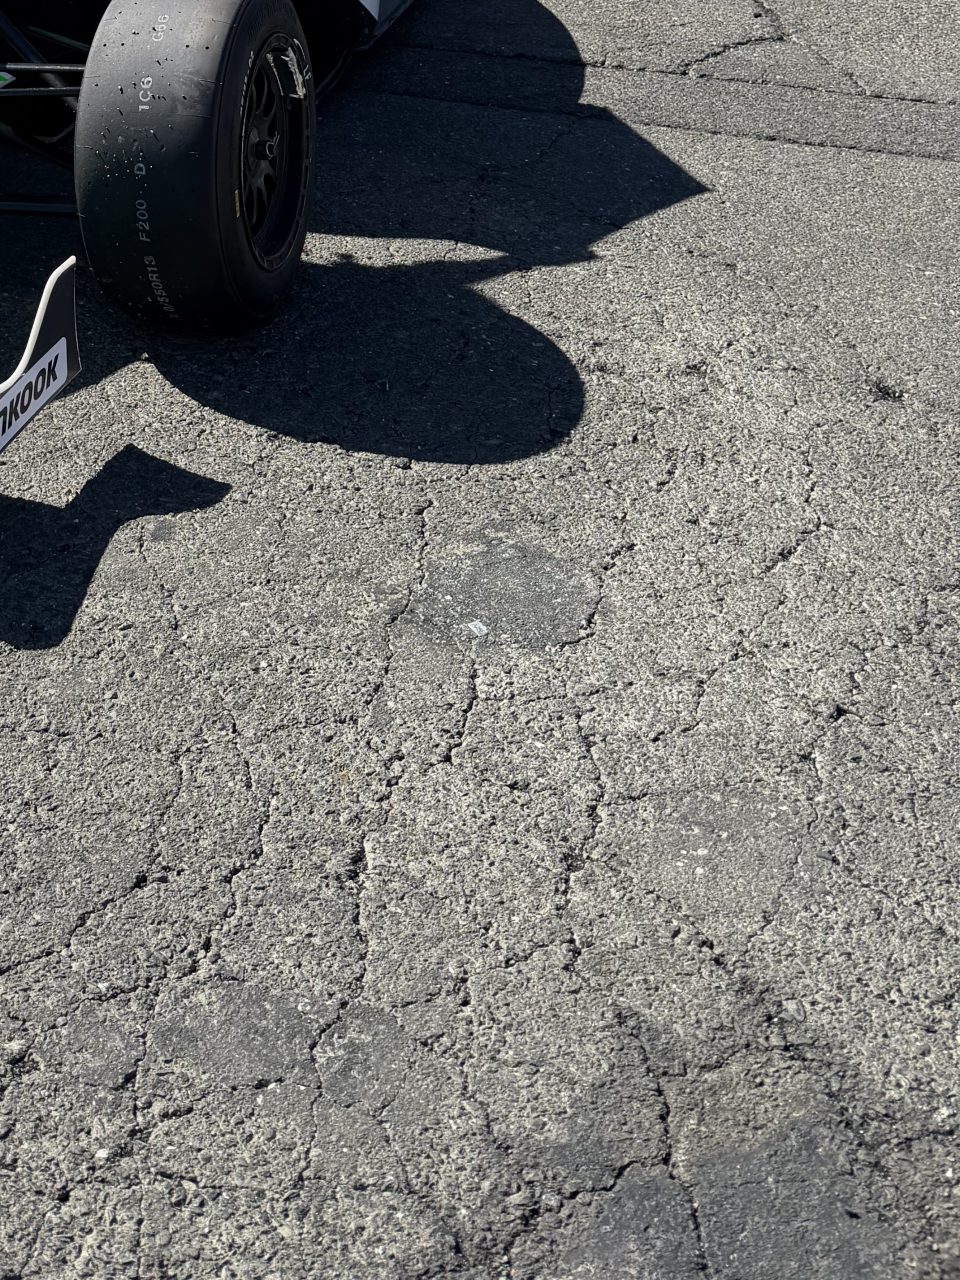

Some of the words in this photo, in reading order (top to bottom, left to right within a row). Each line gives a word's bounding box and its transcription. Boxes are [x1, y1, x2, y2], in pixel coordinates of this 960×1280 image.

[152, 14, 169, 42] G66
[138, 76, 152, 111] 1C6
[135, 199, 152, 242] F200
